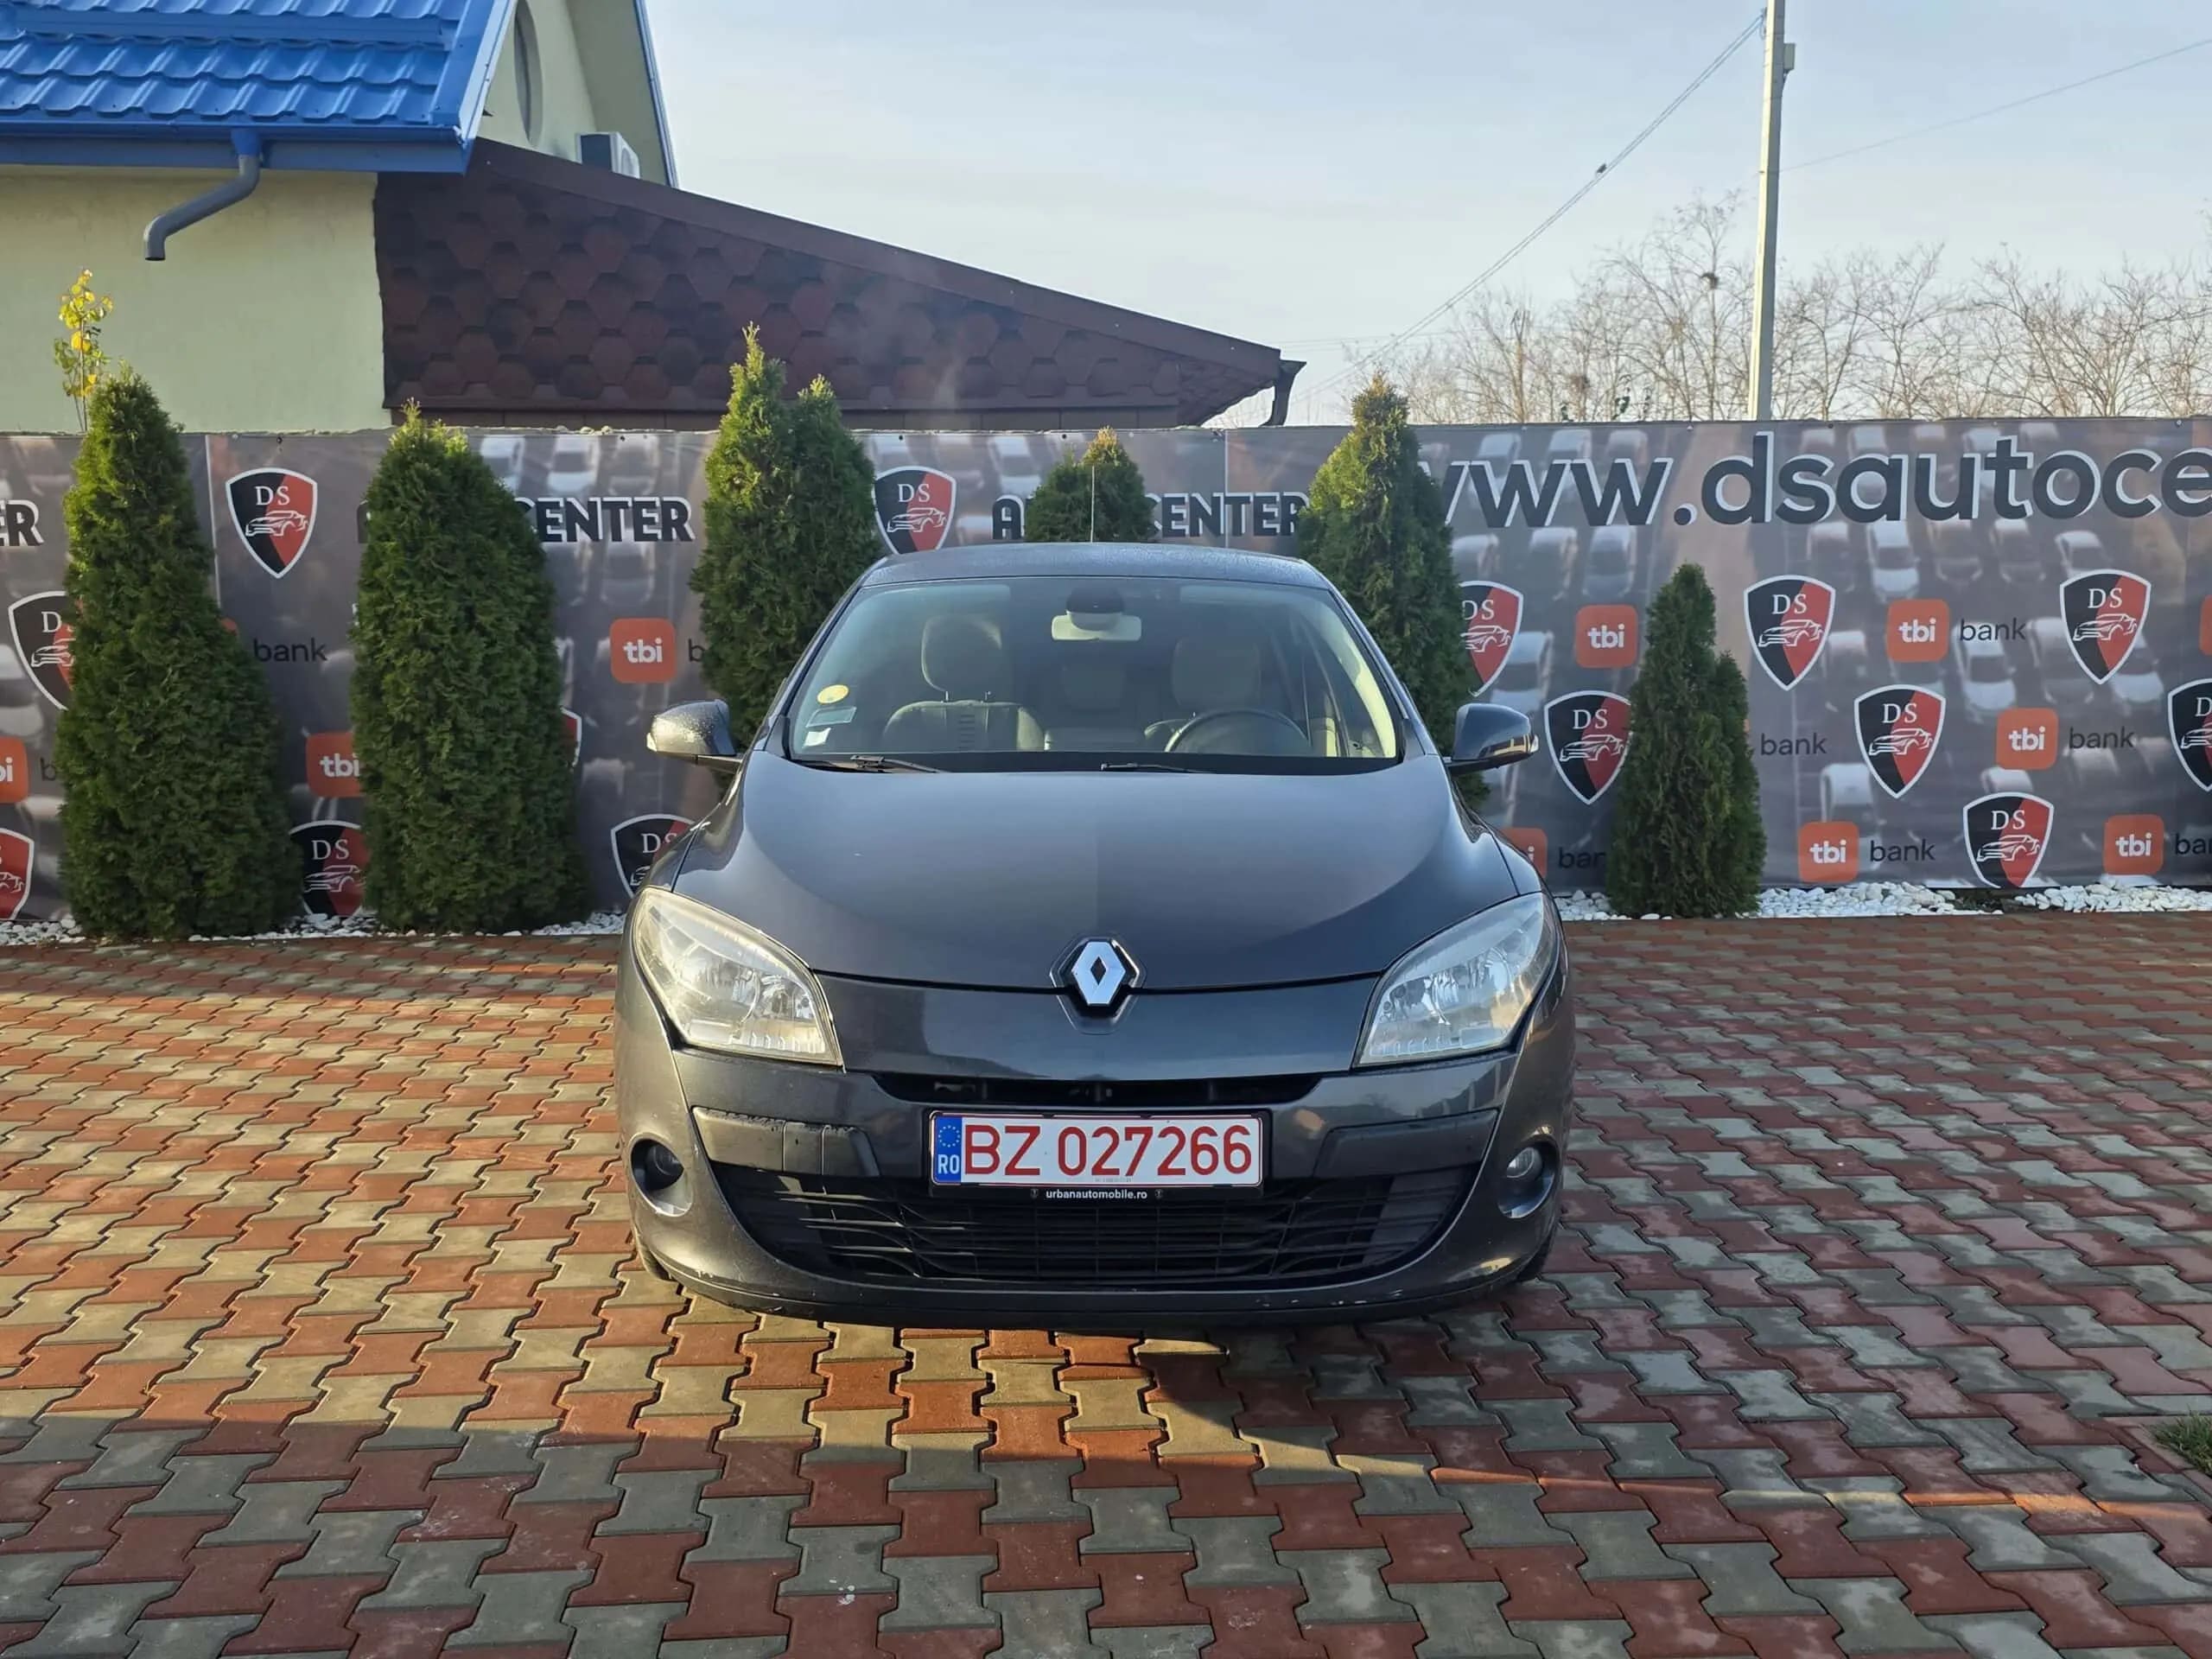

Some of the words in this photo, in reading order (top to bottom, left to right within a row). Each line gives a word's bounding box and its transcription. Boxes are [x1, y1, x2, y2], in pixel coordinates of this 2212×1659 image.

[255, 486, 291, 506] DS
[898, 483, 931, 503] DS
[515, 497, 695, 543] ENTER
[1772, 594, 1807, 614] DS
[2088, 588, 2123, 608] DS
[1587, 624, 1624, 648] tbi
[1898, 617, 1936, 643] tbi
[1960, 617, 2026, 641] bank
[253, 637, 327, 663] bank
[623, 638, 663, 664] tbi
[1573, 709, 1608, 730] DS
[1882, 702, 1917, 723] DS
[1760, 733, 1827, 756] bank
[2008, 726, 2045, 751] tbi
[2069, 727, 2135, 750] bank
[319, 753, 359, 778] tbi
[1991, 810, 2025, 830] DS
[311, 839, 350, 861] DS
[1809, 839, 1847, 864] tbi
[1870, 839, 1936, 862] bank
[2115, 832, 2152, 857] tbi
[2175, 832, 2212, 855] ba
[965, 1124, 1040, 1176] BZ
[1058, 1124, 1252, 1176] 027266
[938, 1154, 960, 1174] RO
[1046, 1188, 1148, 1199] urbanautomobile.ro
